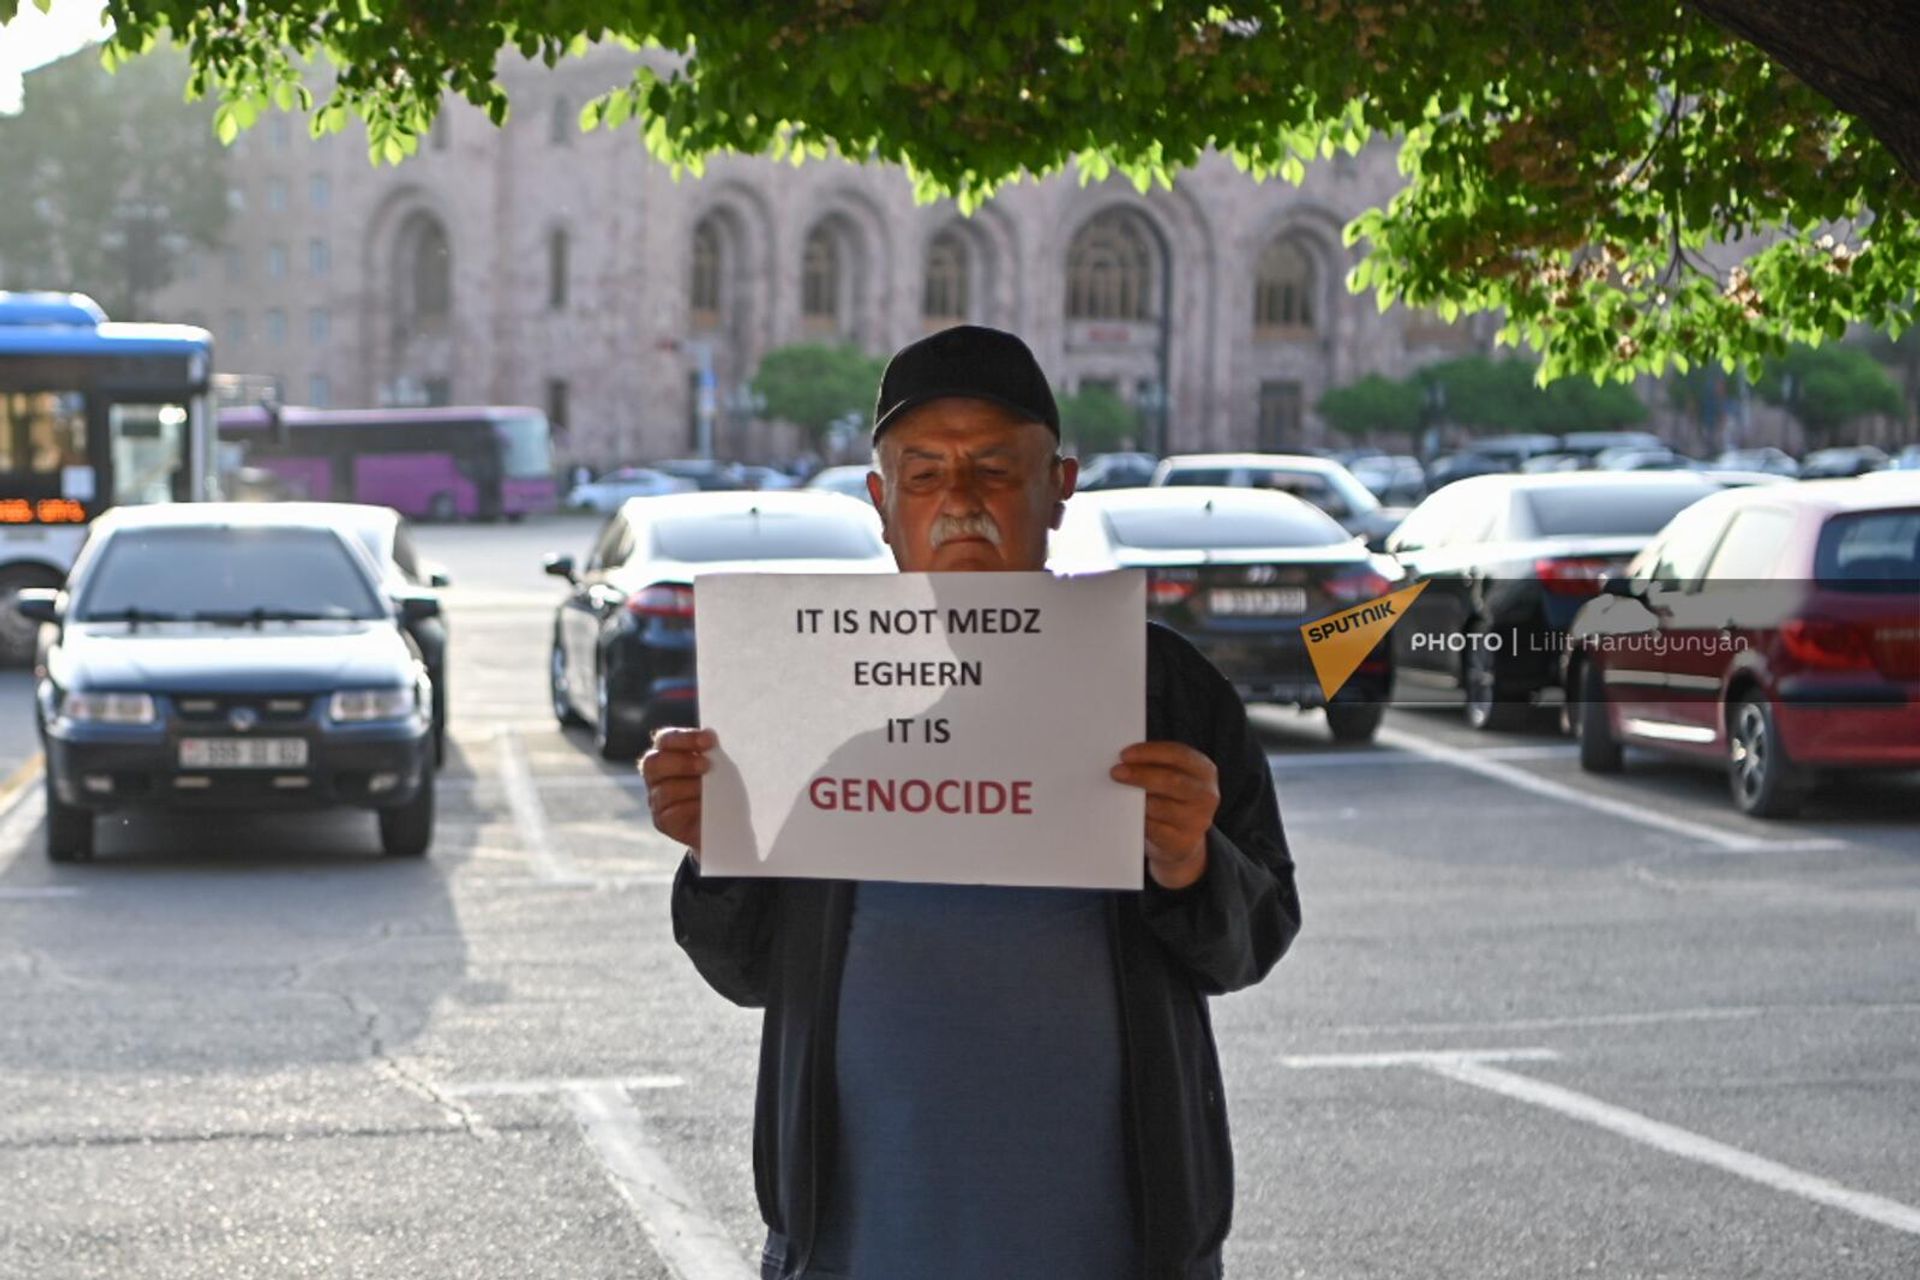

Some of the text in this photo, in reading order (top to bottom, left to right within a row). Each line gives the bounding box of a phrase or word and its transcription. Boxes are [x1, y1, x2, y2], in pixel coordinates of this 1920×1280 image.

[797, 608, 1042, 634] IT IS NOT MEDZ
[854, 661, 982, 686] EGHERN
[887, 718, 951, 744] IT IS
[808, 776, 1033, 815] GENOCIDE
